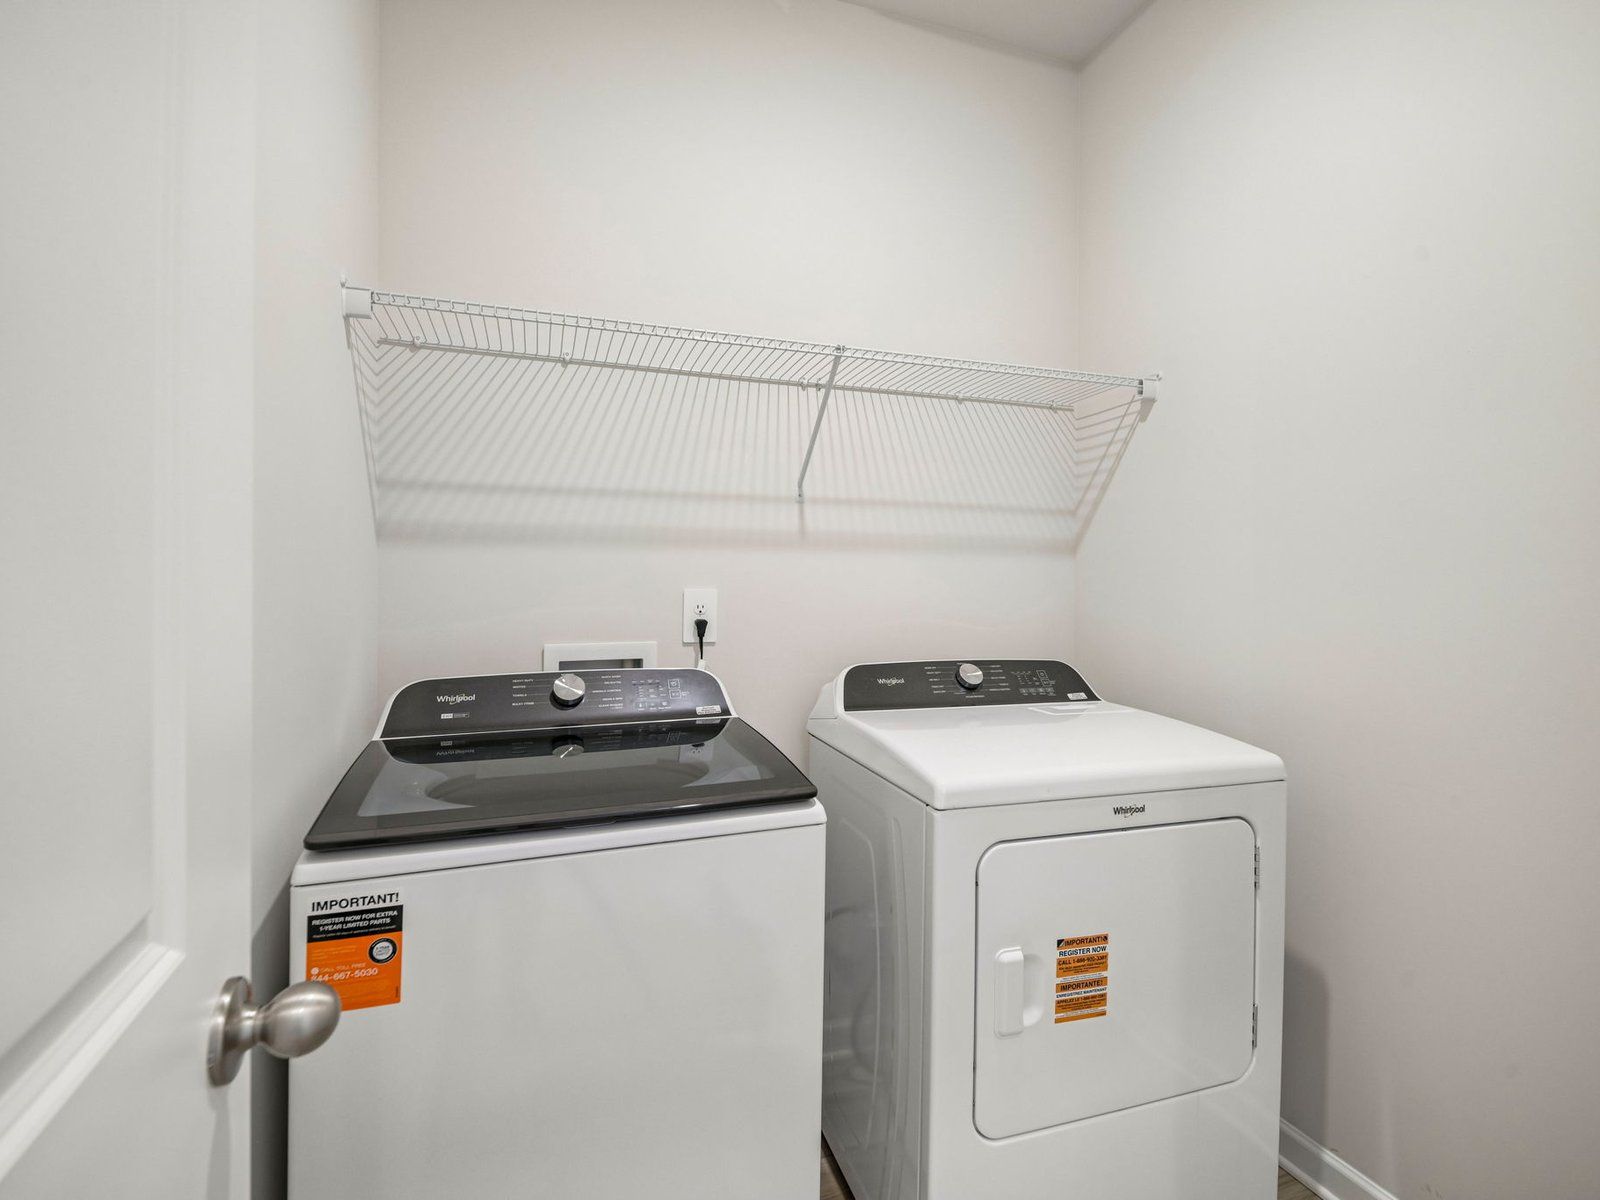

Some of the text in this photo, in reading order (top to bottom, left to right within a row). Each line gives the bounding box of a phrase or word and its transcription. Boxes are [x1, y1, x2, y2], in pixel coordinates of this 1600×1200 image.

[876, 677, 905, 687] Whirlpool
[437, 693, 476, 705] Whirlpool
[1113, 804, 1146, 818] Whirlpool
[311, 892, 399, 912] IMPORTANT!
[311, 916, 344, 926] REGISTER
[376, 910, 398, 918] EXTRA
[343, 920, 369, 929] LIMITED
[369, 917, 391, 926] PARTS
[1059, 945, 1107, 957] REGISTER NOW
